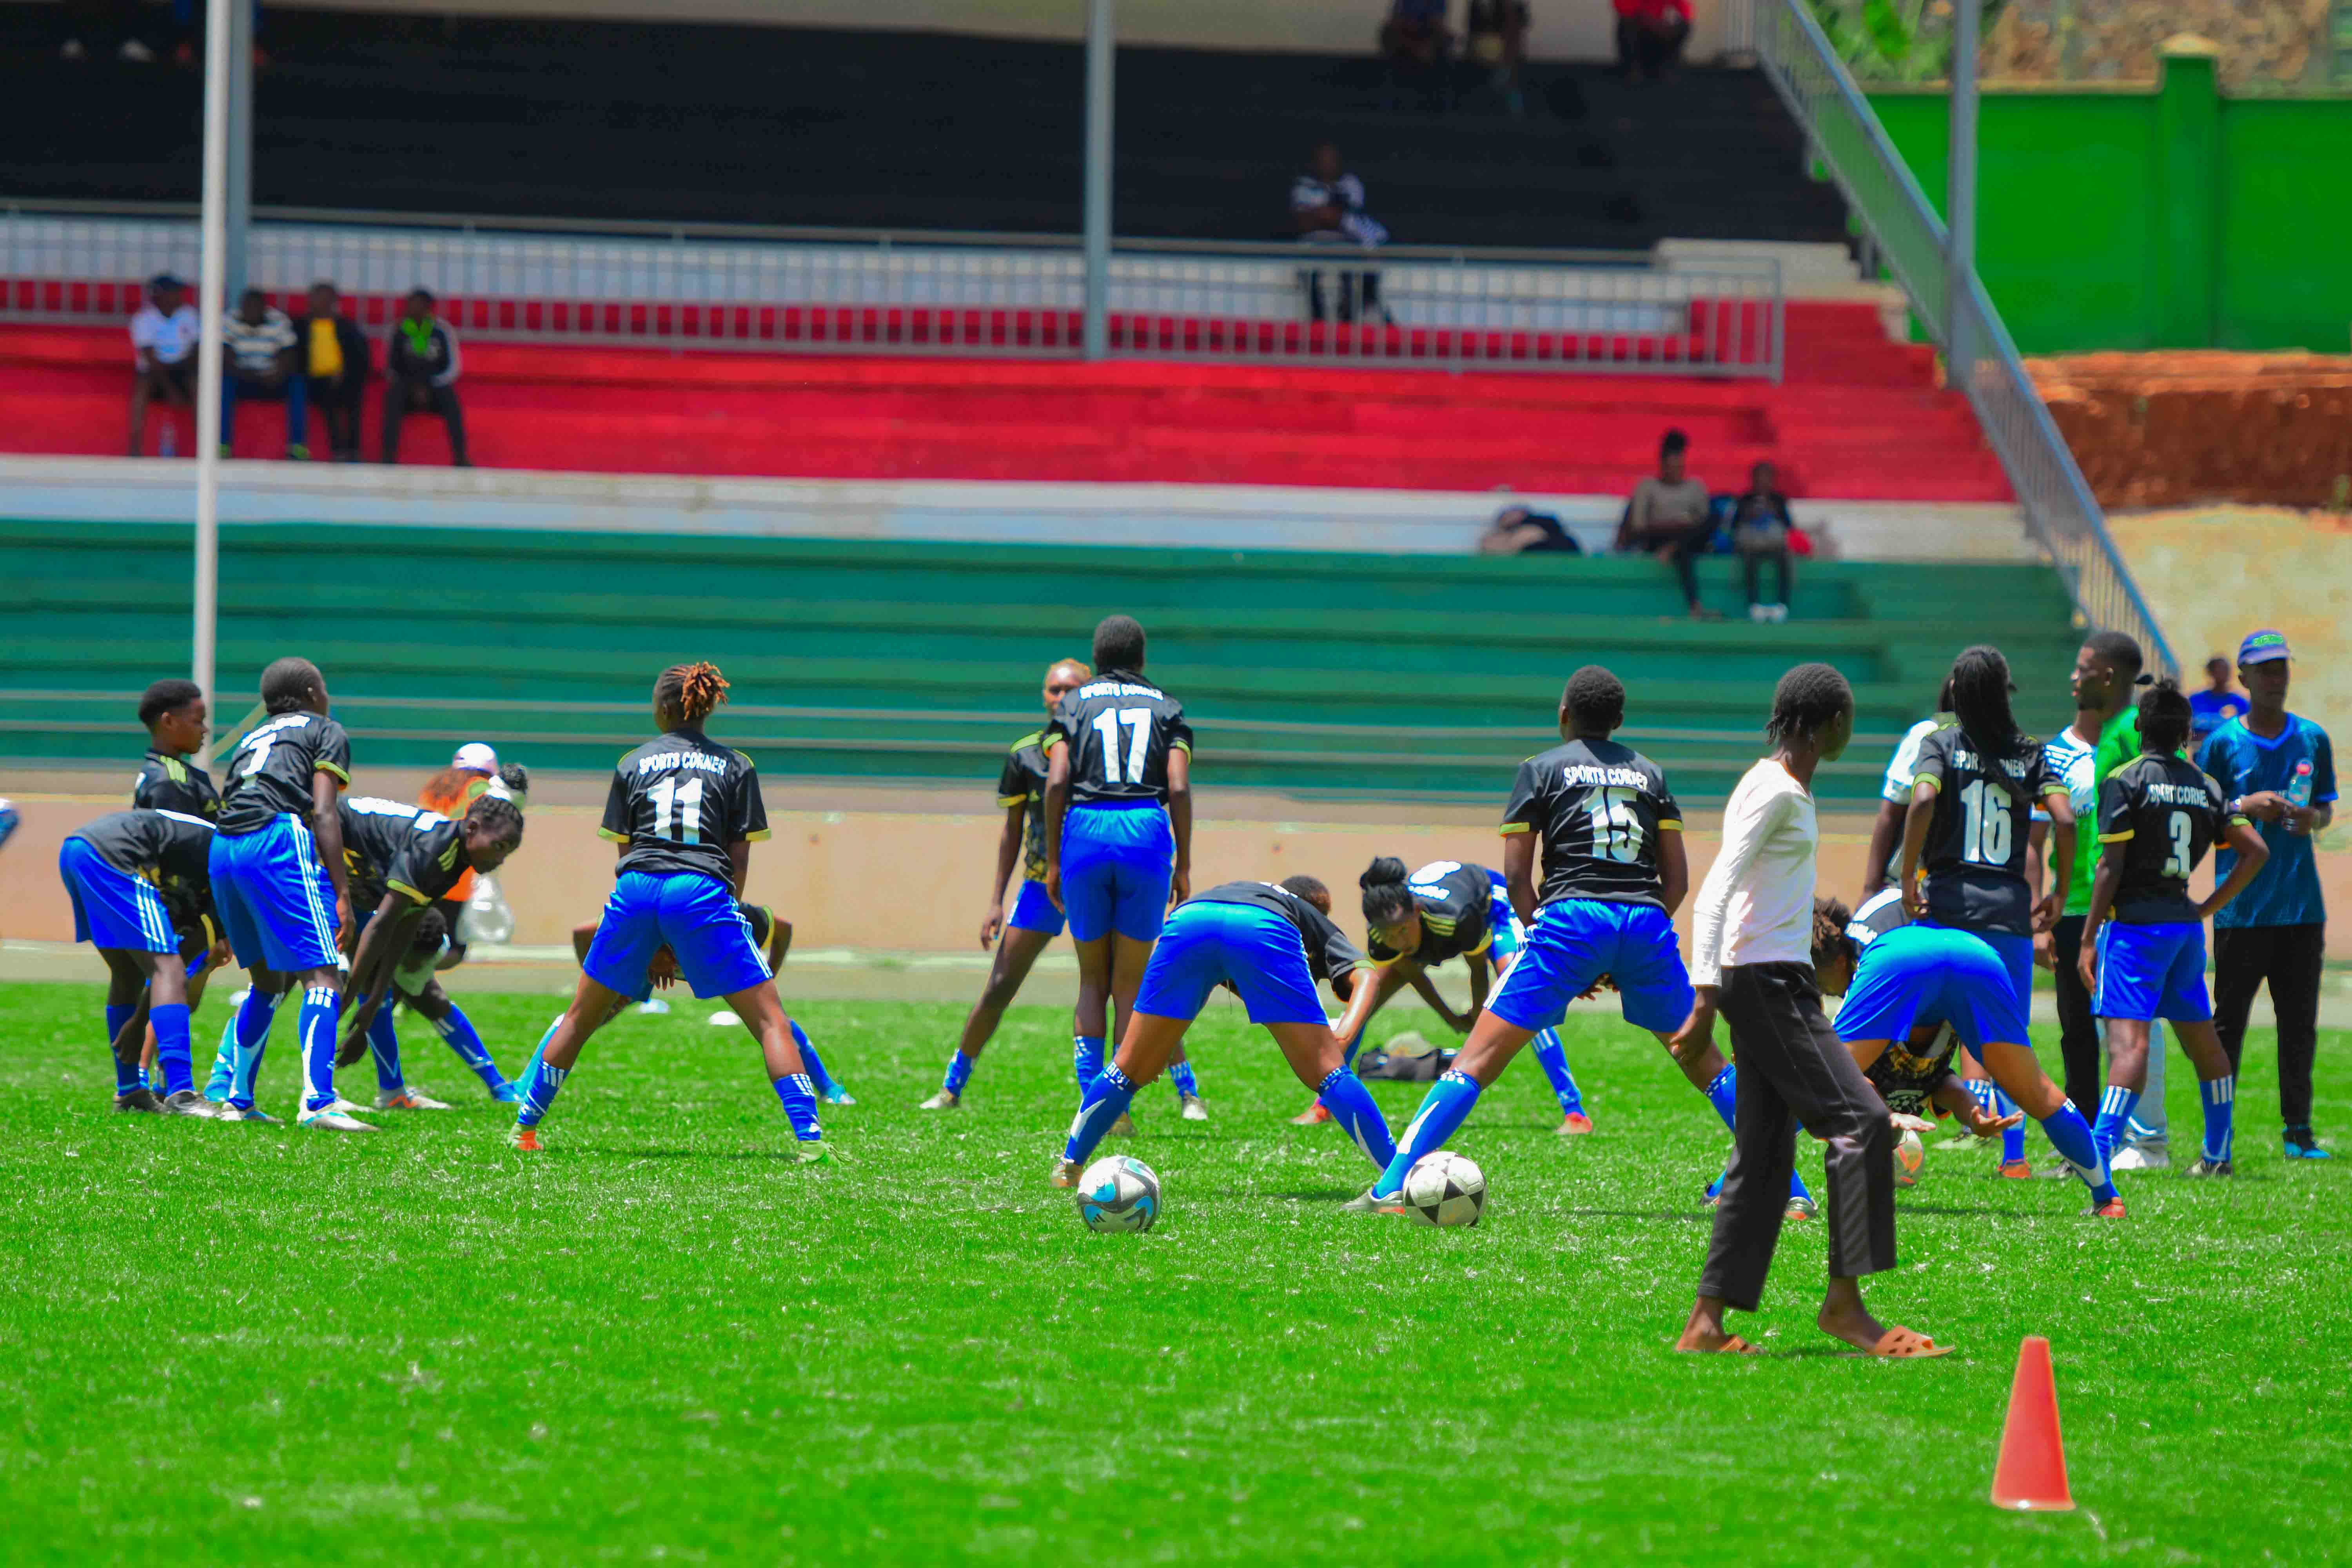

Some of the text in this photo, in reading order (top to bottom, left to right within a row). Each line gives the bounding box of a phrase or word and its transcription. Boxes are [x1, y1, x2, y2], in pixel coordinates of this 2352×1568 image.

[639, 751, 726, 776] SPORTS CORNER
[1093, 708, 1151, 784] 17
[1564, 764, 1607, 786] SPORTS
[647, 777, 702, 844] 11
[1581, 786, 1643, 863] 15
[1961, 779, 2012, 864] 16
[2161, 811, 2192, 879] 3
